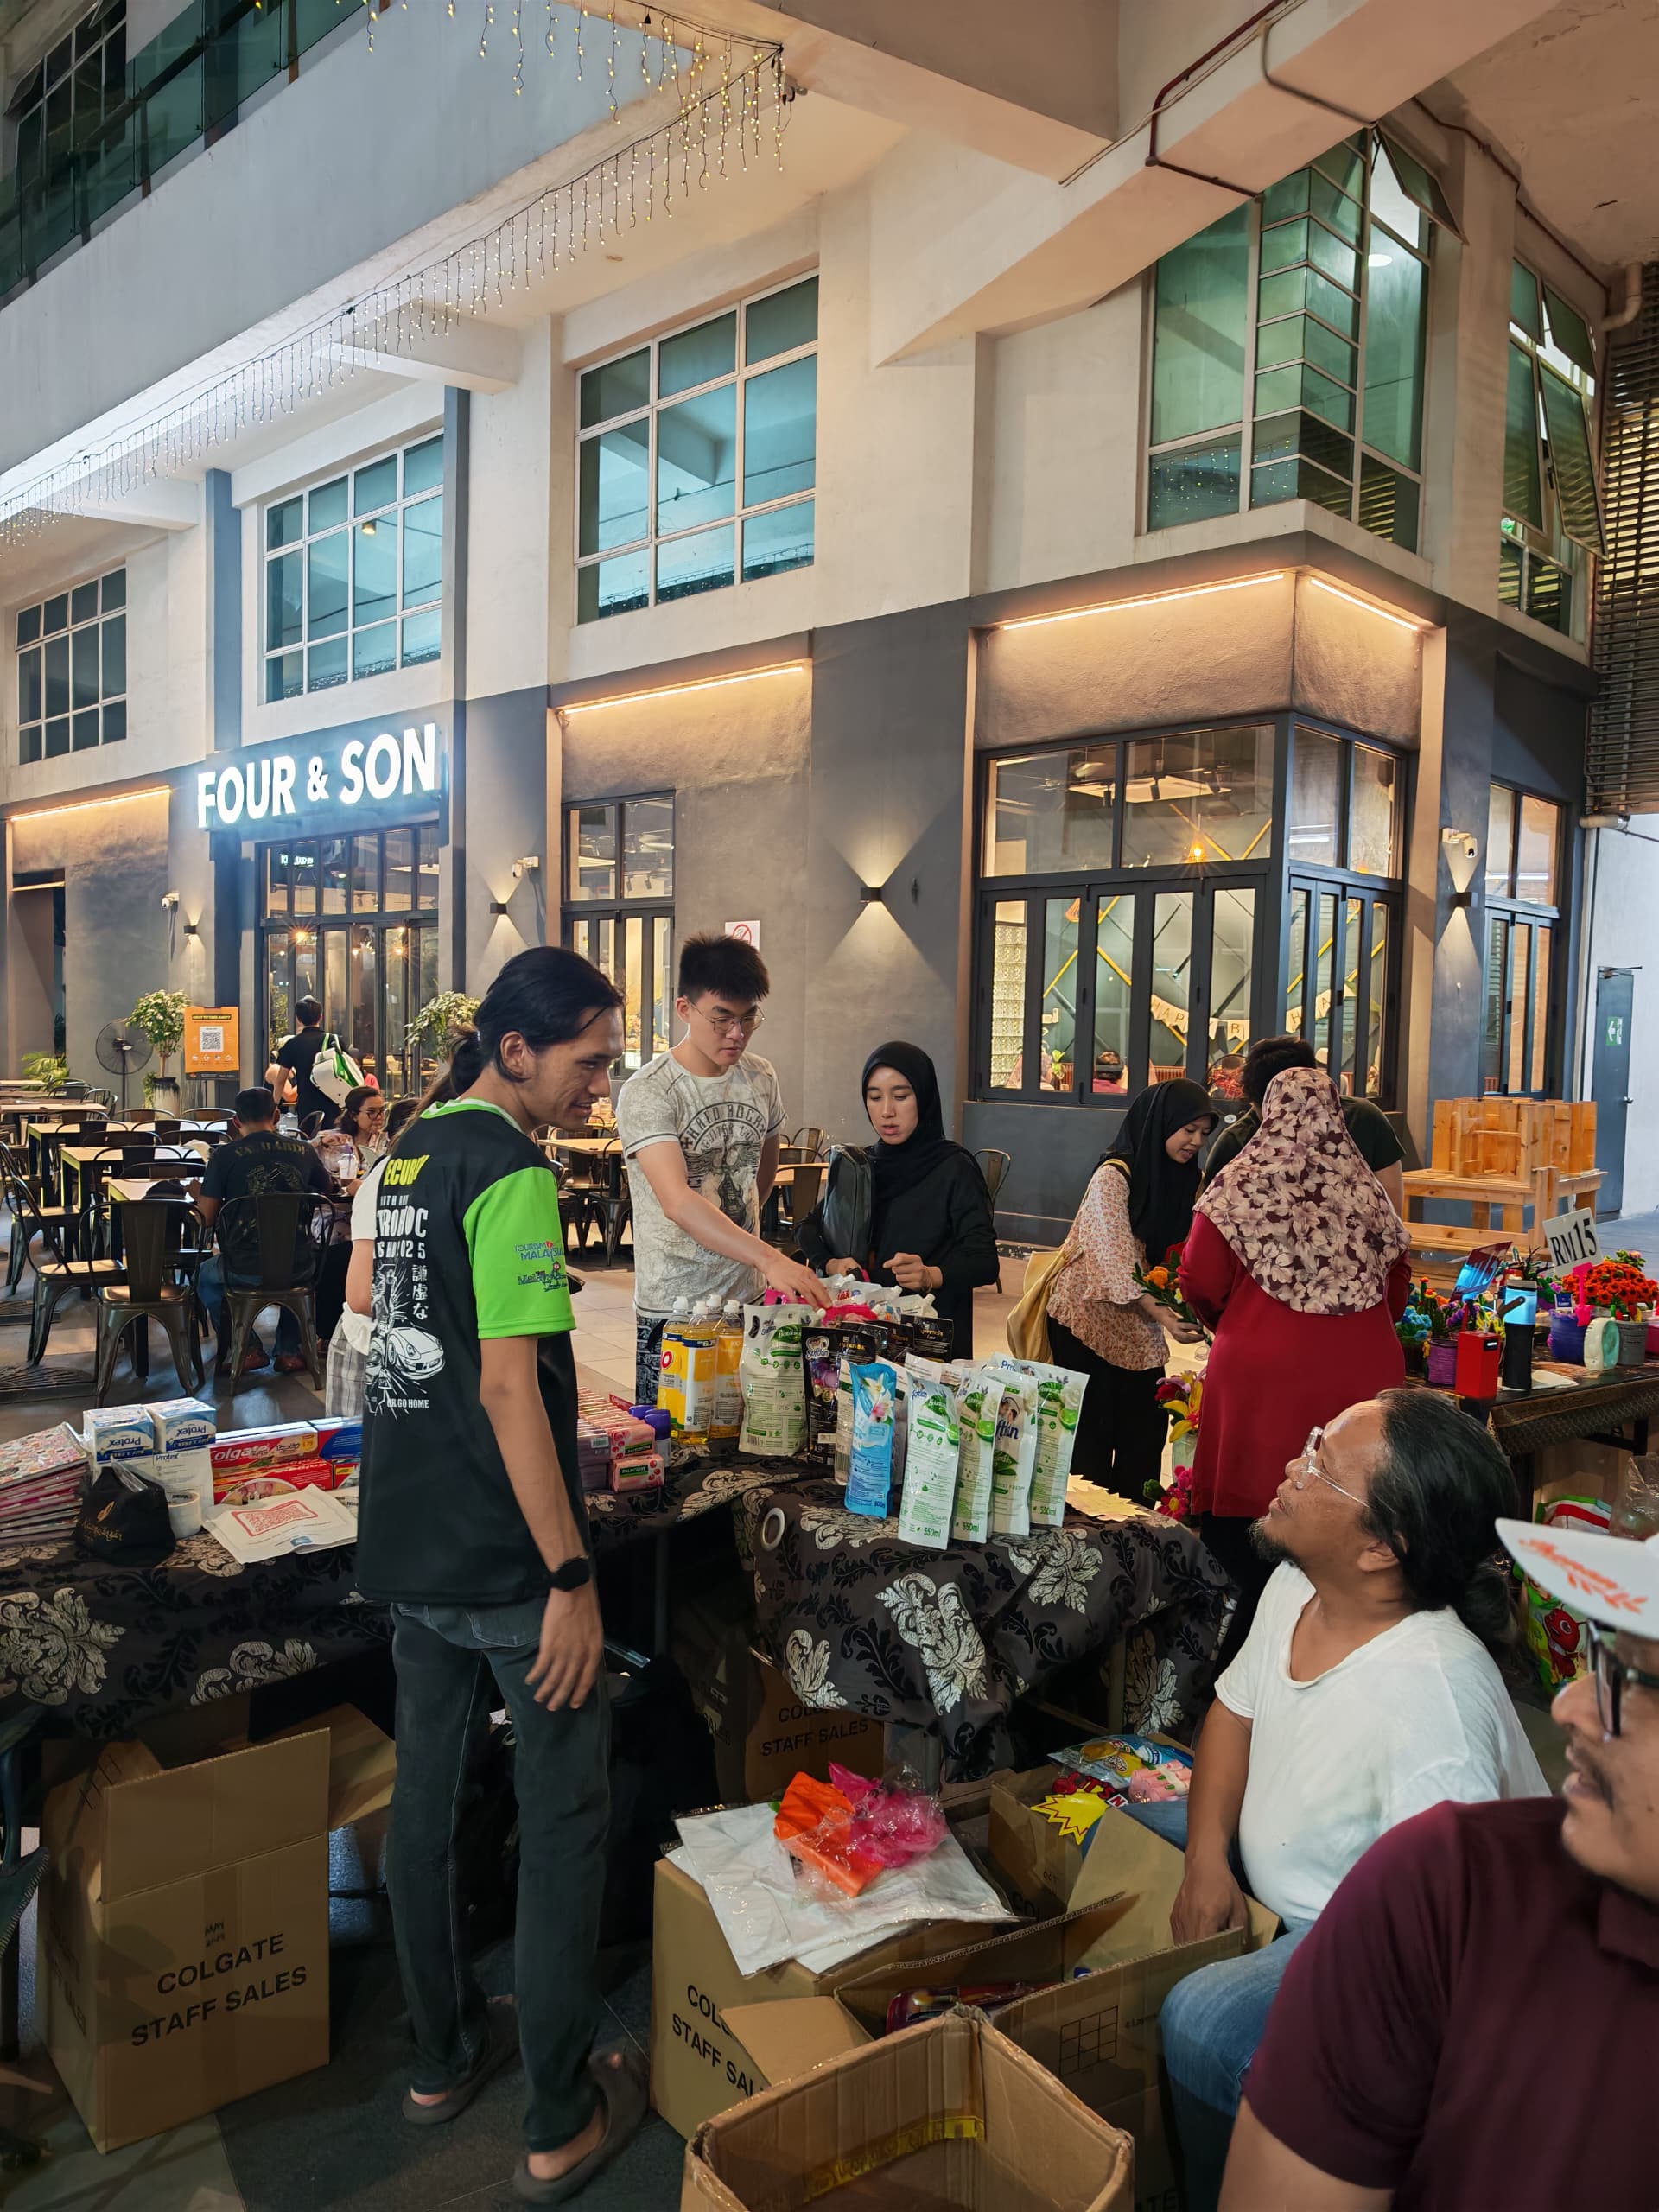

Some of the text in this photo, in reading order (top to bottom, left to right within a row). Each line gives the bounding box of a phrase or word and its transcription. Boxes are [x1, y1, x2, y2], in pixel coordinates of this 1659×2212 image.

[197, 722, 436, 829] FOUR & SON
[1549, 1217, 1597, 1267] RM15
[397, 1398, 407, 1408] GO
[408, 1399, 429, 1408] HOME
[109, 1436, 142, 1447] Protex
[176, 1424, 207, 1437] Protex
[156, 1452, 181, 1461] Protex
[924, 1527, 942, 1538] 550ml
[963, 1522, 980, 1533] 550ml
[760, 1719, 869, 1756] STAFF SALES
[157, 1932, 284, 1994] COLGATE
[131, 1965, 308, 2047] STAFF SALES
[672, 2013, 722, 2068] STAFF
